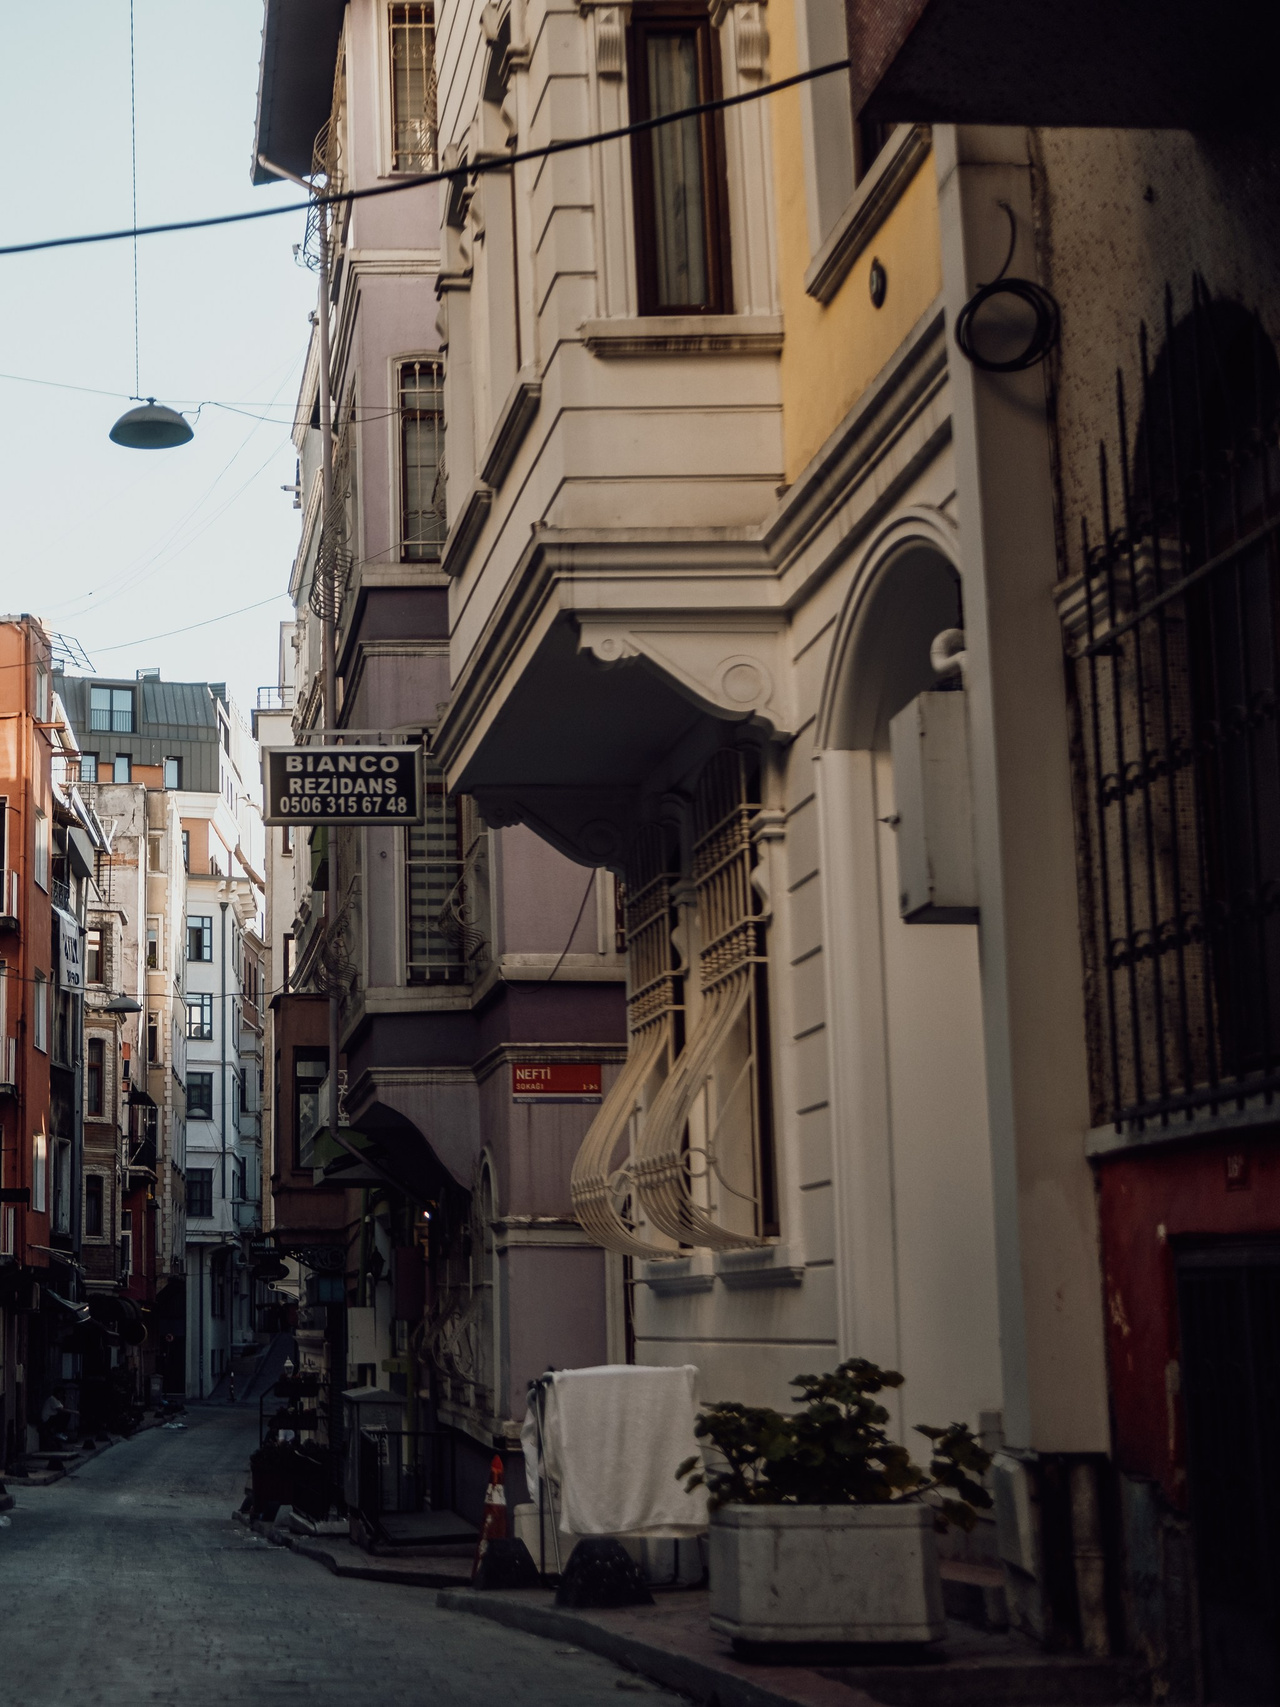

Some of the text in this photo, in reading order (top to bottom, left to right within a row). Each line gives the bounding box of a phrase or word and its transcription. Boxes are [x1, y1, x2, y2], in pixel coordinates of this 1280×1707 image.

[285, 755, 400, 773] BIANCO
[289, 775, 398, 795] REZİDANS
[279, 796, 408, 814] 0506 315 67 48
[516, 1066, 551, 1080] NEFTİ
[516, 1082, 544, 1090] SOKAĞI
